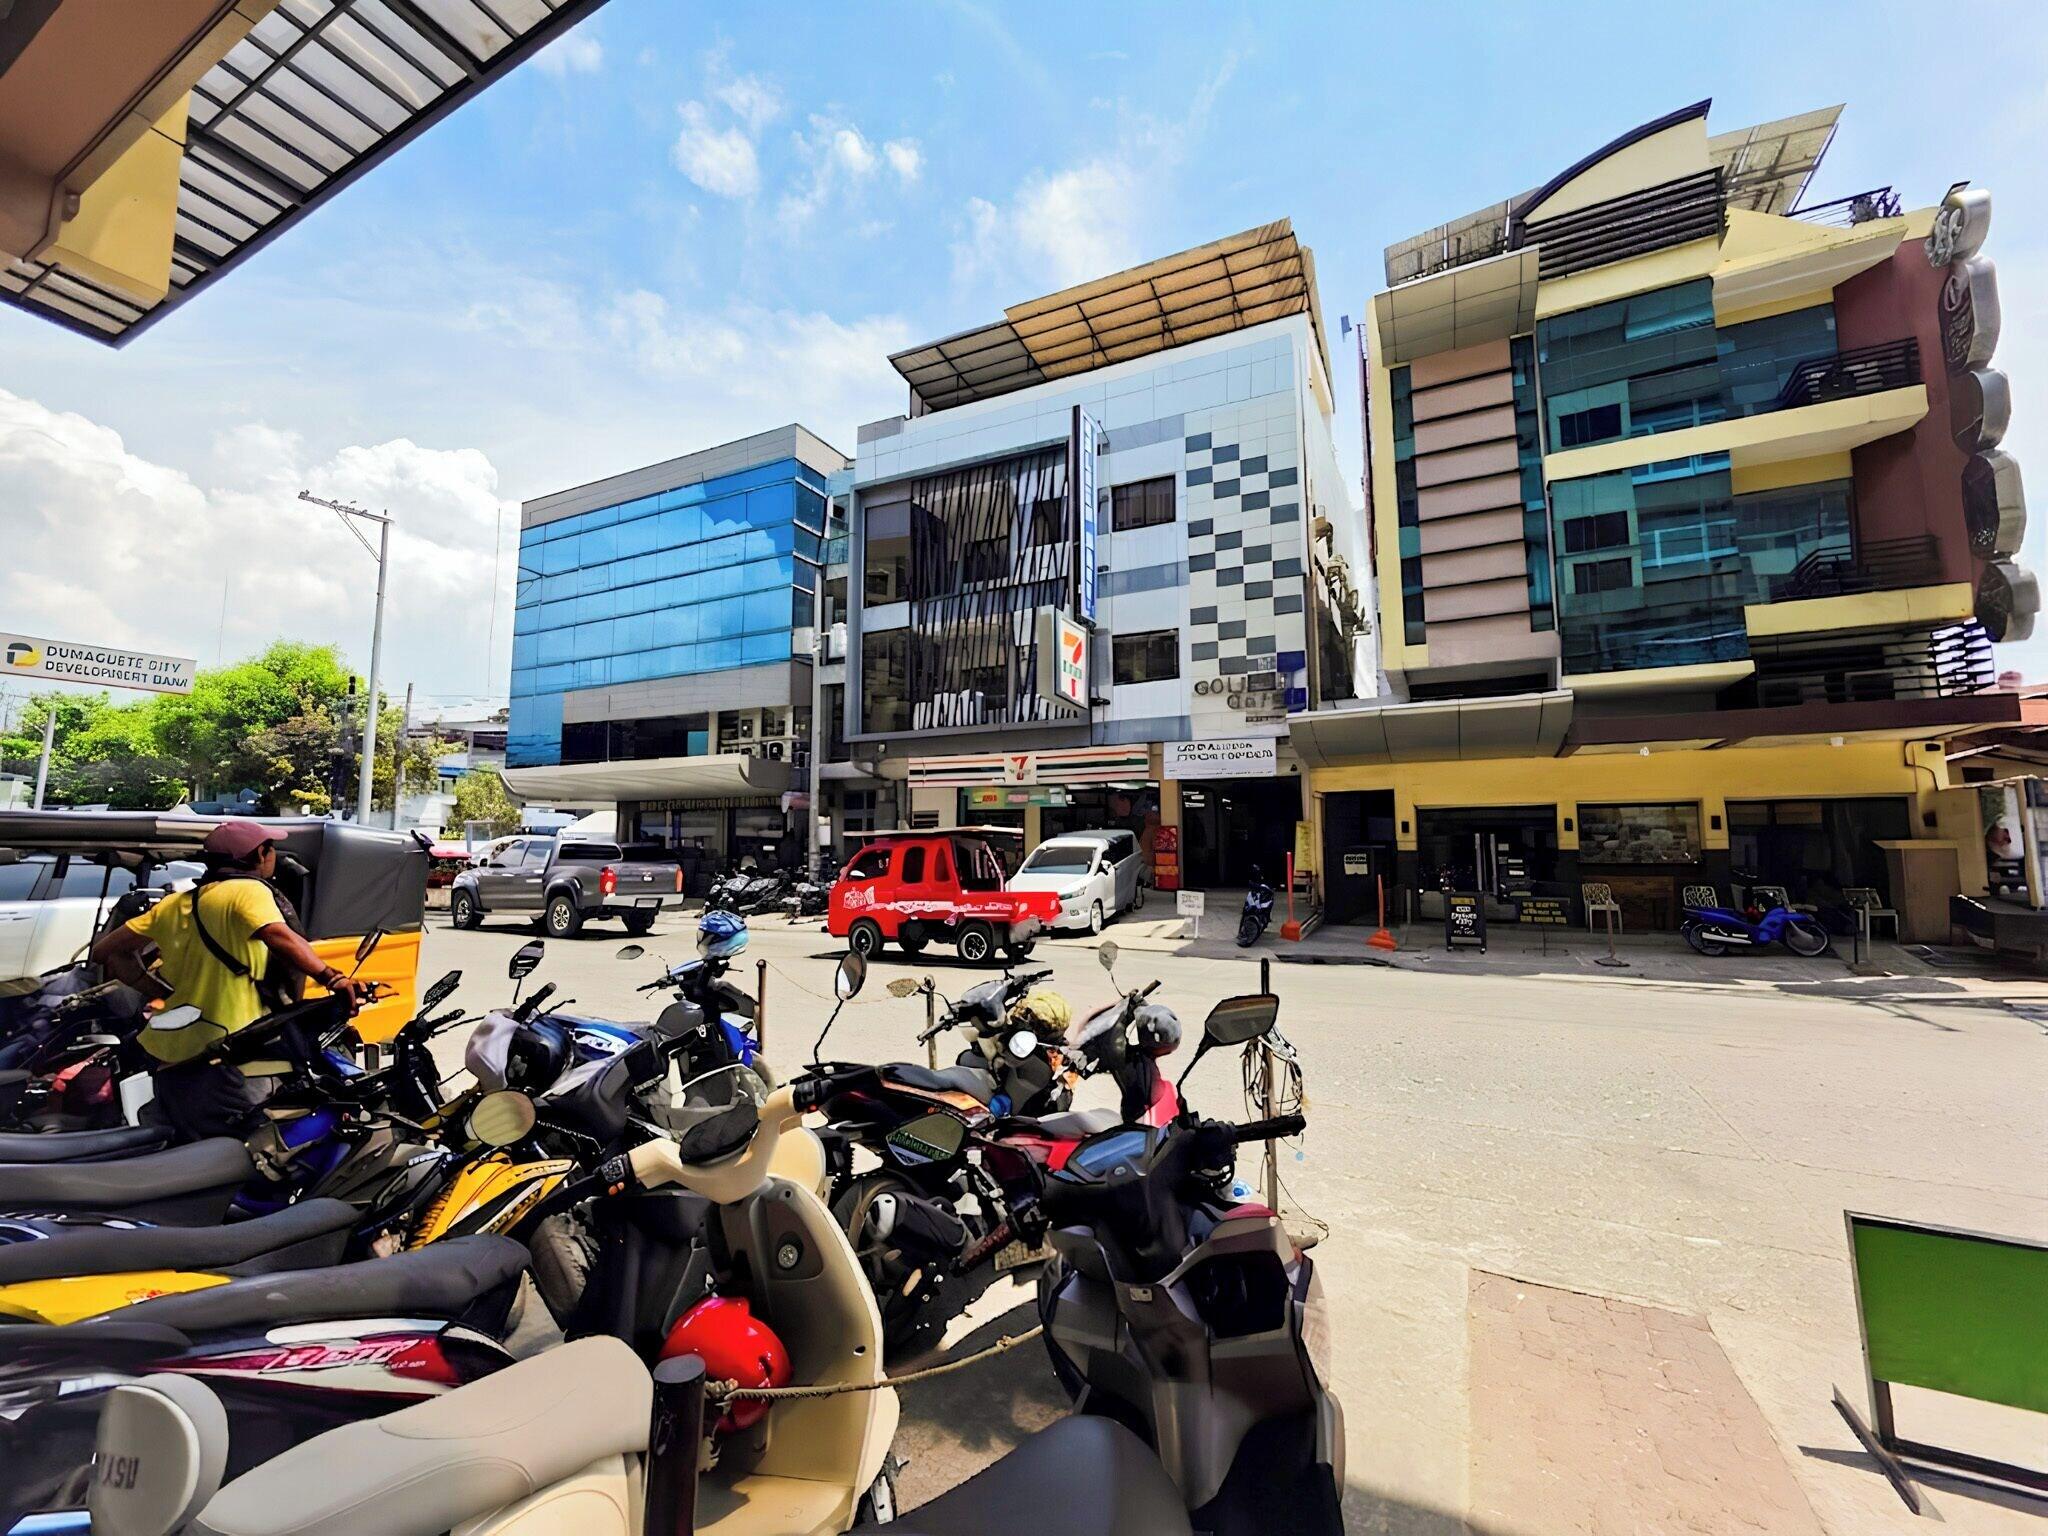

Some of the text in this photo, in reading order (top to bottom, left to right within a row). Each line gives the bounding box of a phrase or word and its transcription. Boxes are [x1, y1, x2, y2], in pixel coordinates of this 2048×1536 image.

[46, 646, 182, 673] DUMAGUETE CITY
[45, 661, 148, 683] DEVELOPMENT
